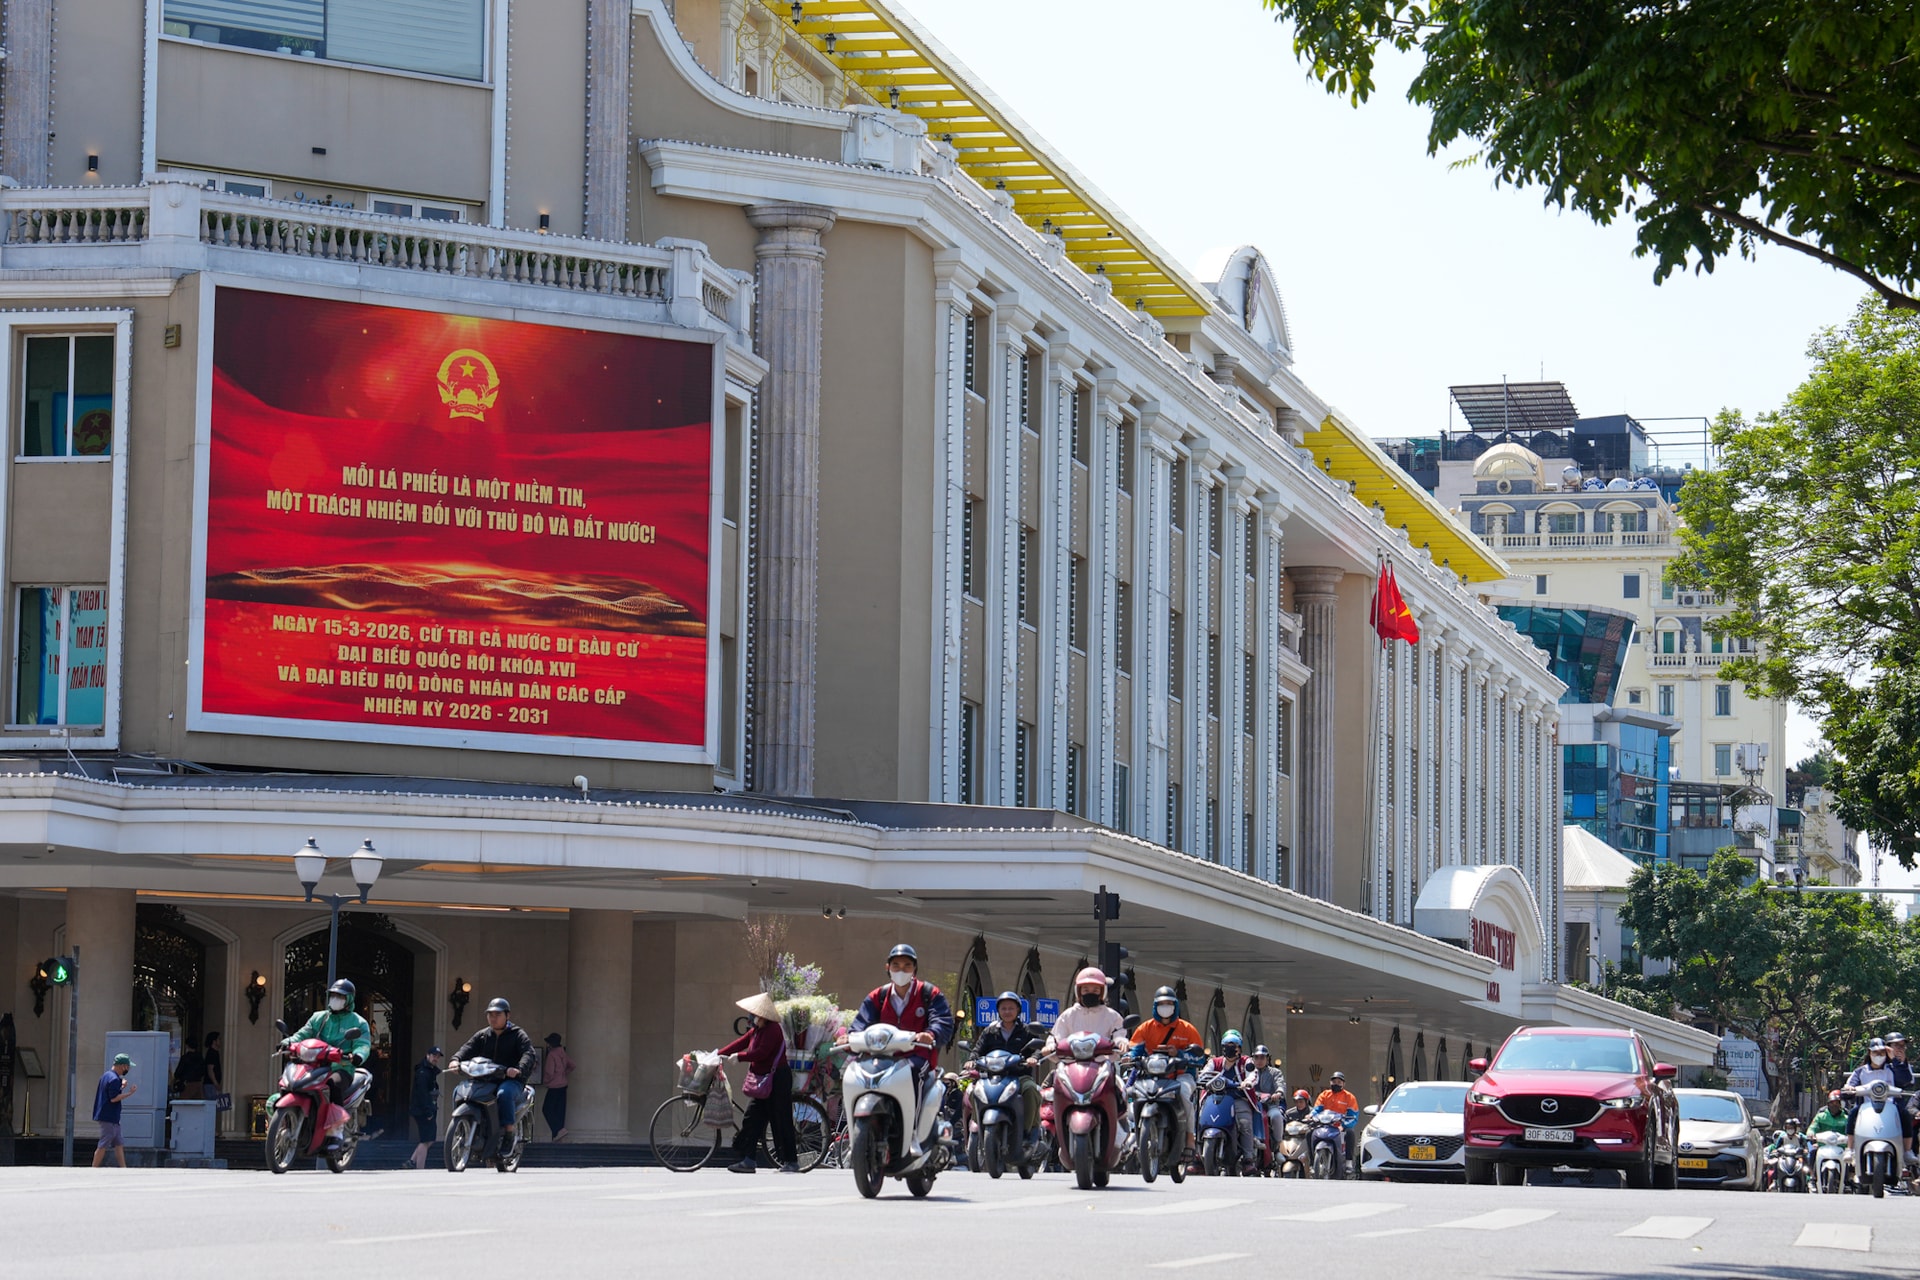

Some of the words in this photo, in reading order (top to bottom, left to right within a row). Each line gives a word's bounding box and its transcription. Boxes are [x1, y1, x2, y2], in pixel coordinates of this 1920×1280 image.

[342, 461, 374, 488] MỖI
[379, 467, 398, 490] LÁ
[402, 468, 449, 495] PHIẾU
[453, 474, 472, 497] LÀ
[475, 477, 511, 503] MỘT
[514, 478, 553, 505] NIỀM
[557, 486, 587, 509] TIN,
[266, 488, 303, 514] MỘT
[307, 493, 362, 517] TRÁCH
[366, 499, 417, 525] NHIỆM
[421, 499, 450, 526] ĐỐI
[454, 505, 482, 529] VỚI
[486, 508, 518, 532] THỦ
[522, 511, 544, 534] ĐÔ
[548, 514, 569, 537] VÀ
[573, 516, 604, 539] ĐẤT
[608, 521, 656, 544] NƯỚC!
[272, 614, 318, 633] NGÀY
[322, 616, 414, 642] 15-3-2026,
[419, 623, 444, 643] CỬ
[447, 628, 474, 646] TRI
[479, 628, 502, 648] CẢ
[506, 632, 551, 652] NƯỚC
[556, 637, 574, 653] ĐI
[578, 635, 611, 656] BẦU
[616, 639, 640, 658] CỬ
[337, 644, 367, 664] ĐẠI
[372, 644, 411, 666] BIỂU
[415, 648, 461, 669] QUỐC
[466, 653, 495, 674] HỘI
[500, 657, 545, 676] KHÓA
[549, 660, 576, 678] XVI
[277, 663, 300, 682] VÀ
[305, 667, 335, 687] ĐẠI
[340, 666, 379, 688] BIỂU
[384, 671, 413, 693] HỘI
[418, 671, 464, 694] ĐỒNG
[469, 678, 514, 698] NHÂN
[519, 681, 551, 700] DÂN
[556, 684, 589, 703] CÁC
[594, 685, 626, 705] CẤP
[364, 696, 417, 716] NHIỆM
[422, 699, 444, 717] KỲ
[448, 702, 492, 721] 2026
[508, 706, 548, 725] 2031
[1487, 981, 1500, 1002] LAZA
